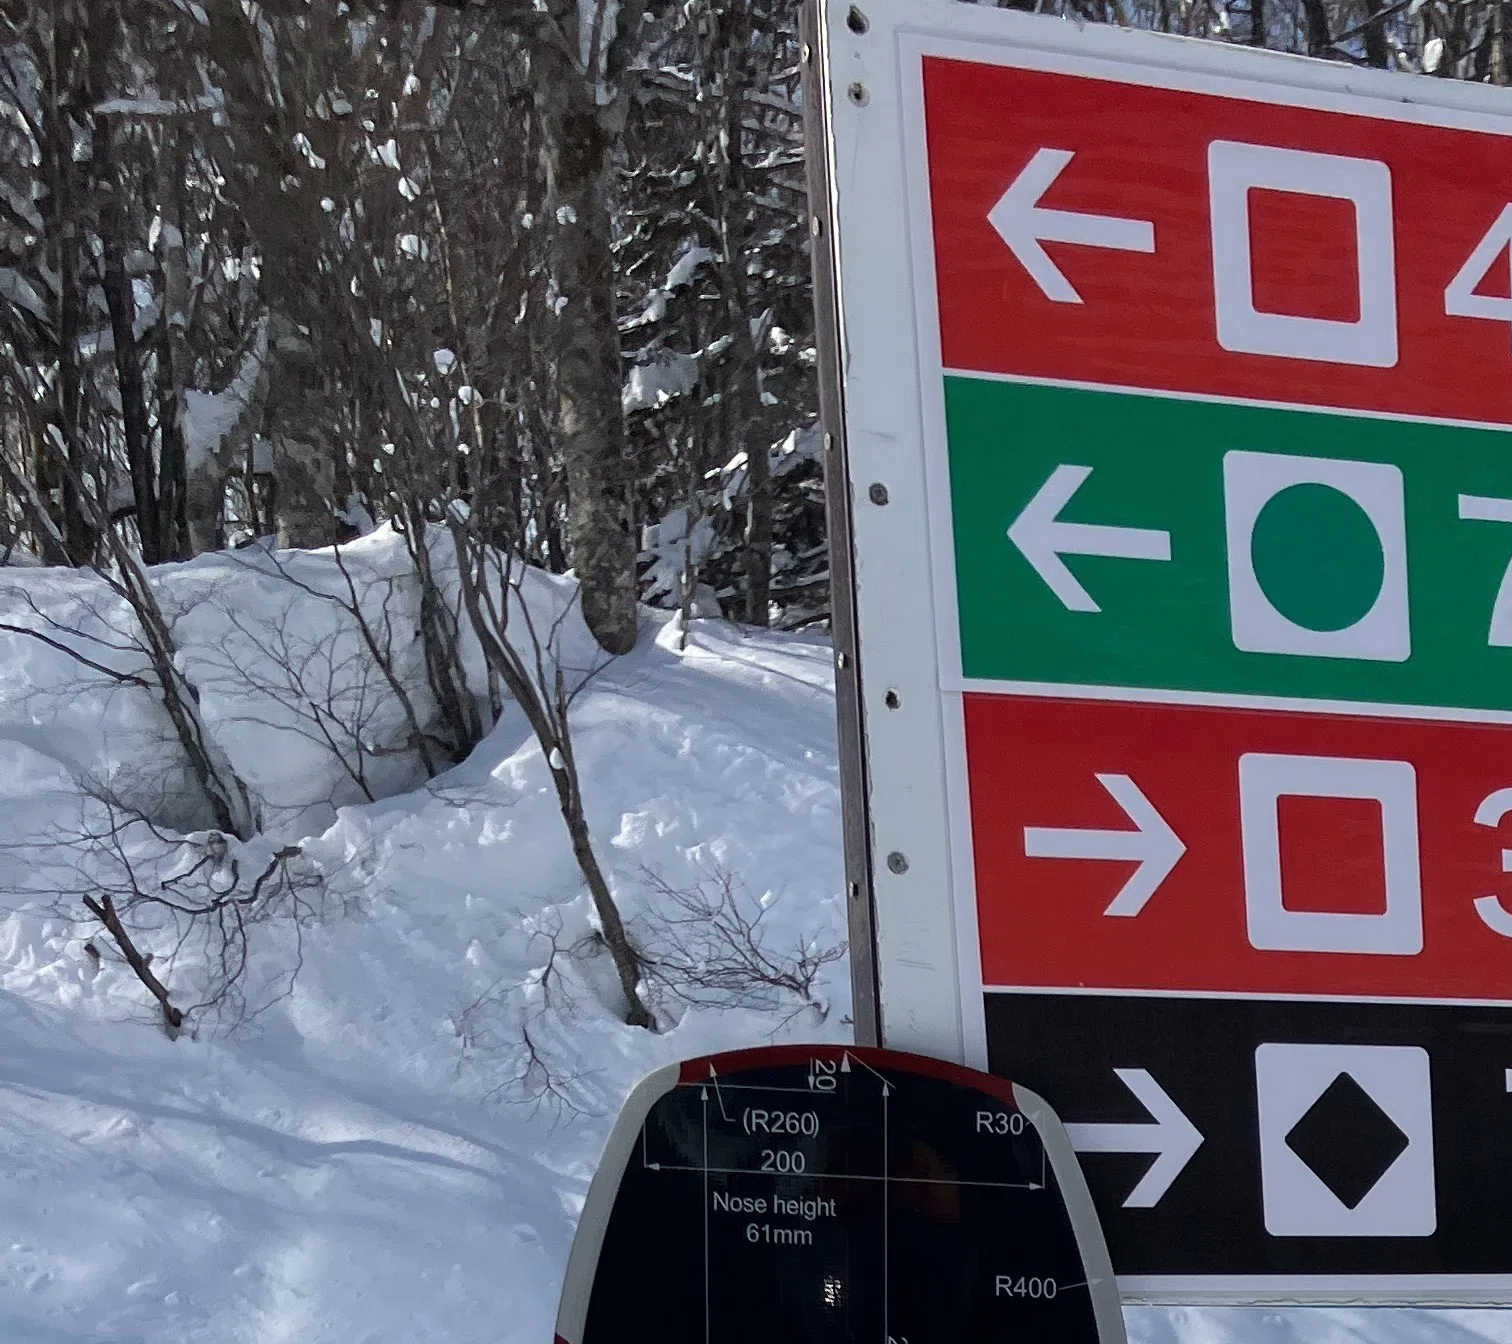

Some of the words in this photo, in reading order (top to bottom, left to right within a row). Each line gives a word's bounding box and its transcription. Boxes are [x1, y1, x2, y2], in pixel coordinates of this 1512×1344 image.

[814, 1059, 837, 1091] 20
[742, 1107, 820, 1138] (R260)
[976, 1112, 1025, 1135] R30
[760, 1150, 806, 1174] 200
[713, 1192, 768, 1216] Nose
[773, 1195, 837, 1221] height
[746, 1224, 813, 1247] 61mm
[995, 1276, 1057, 1300] R400
